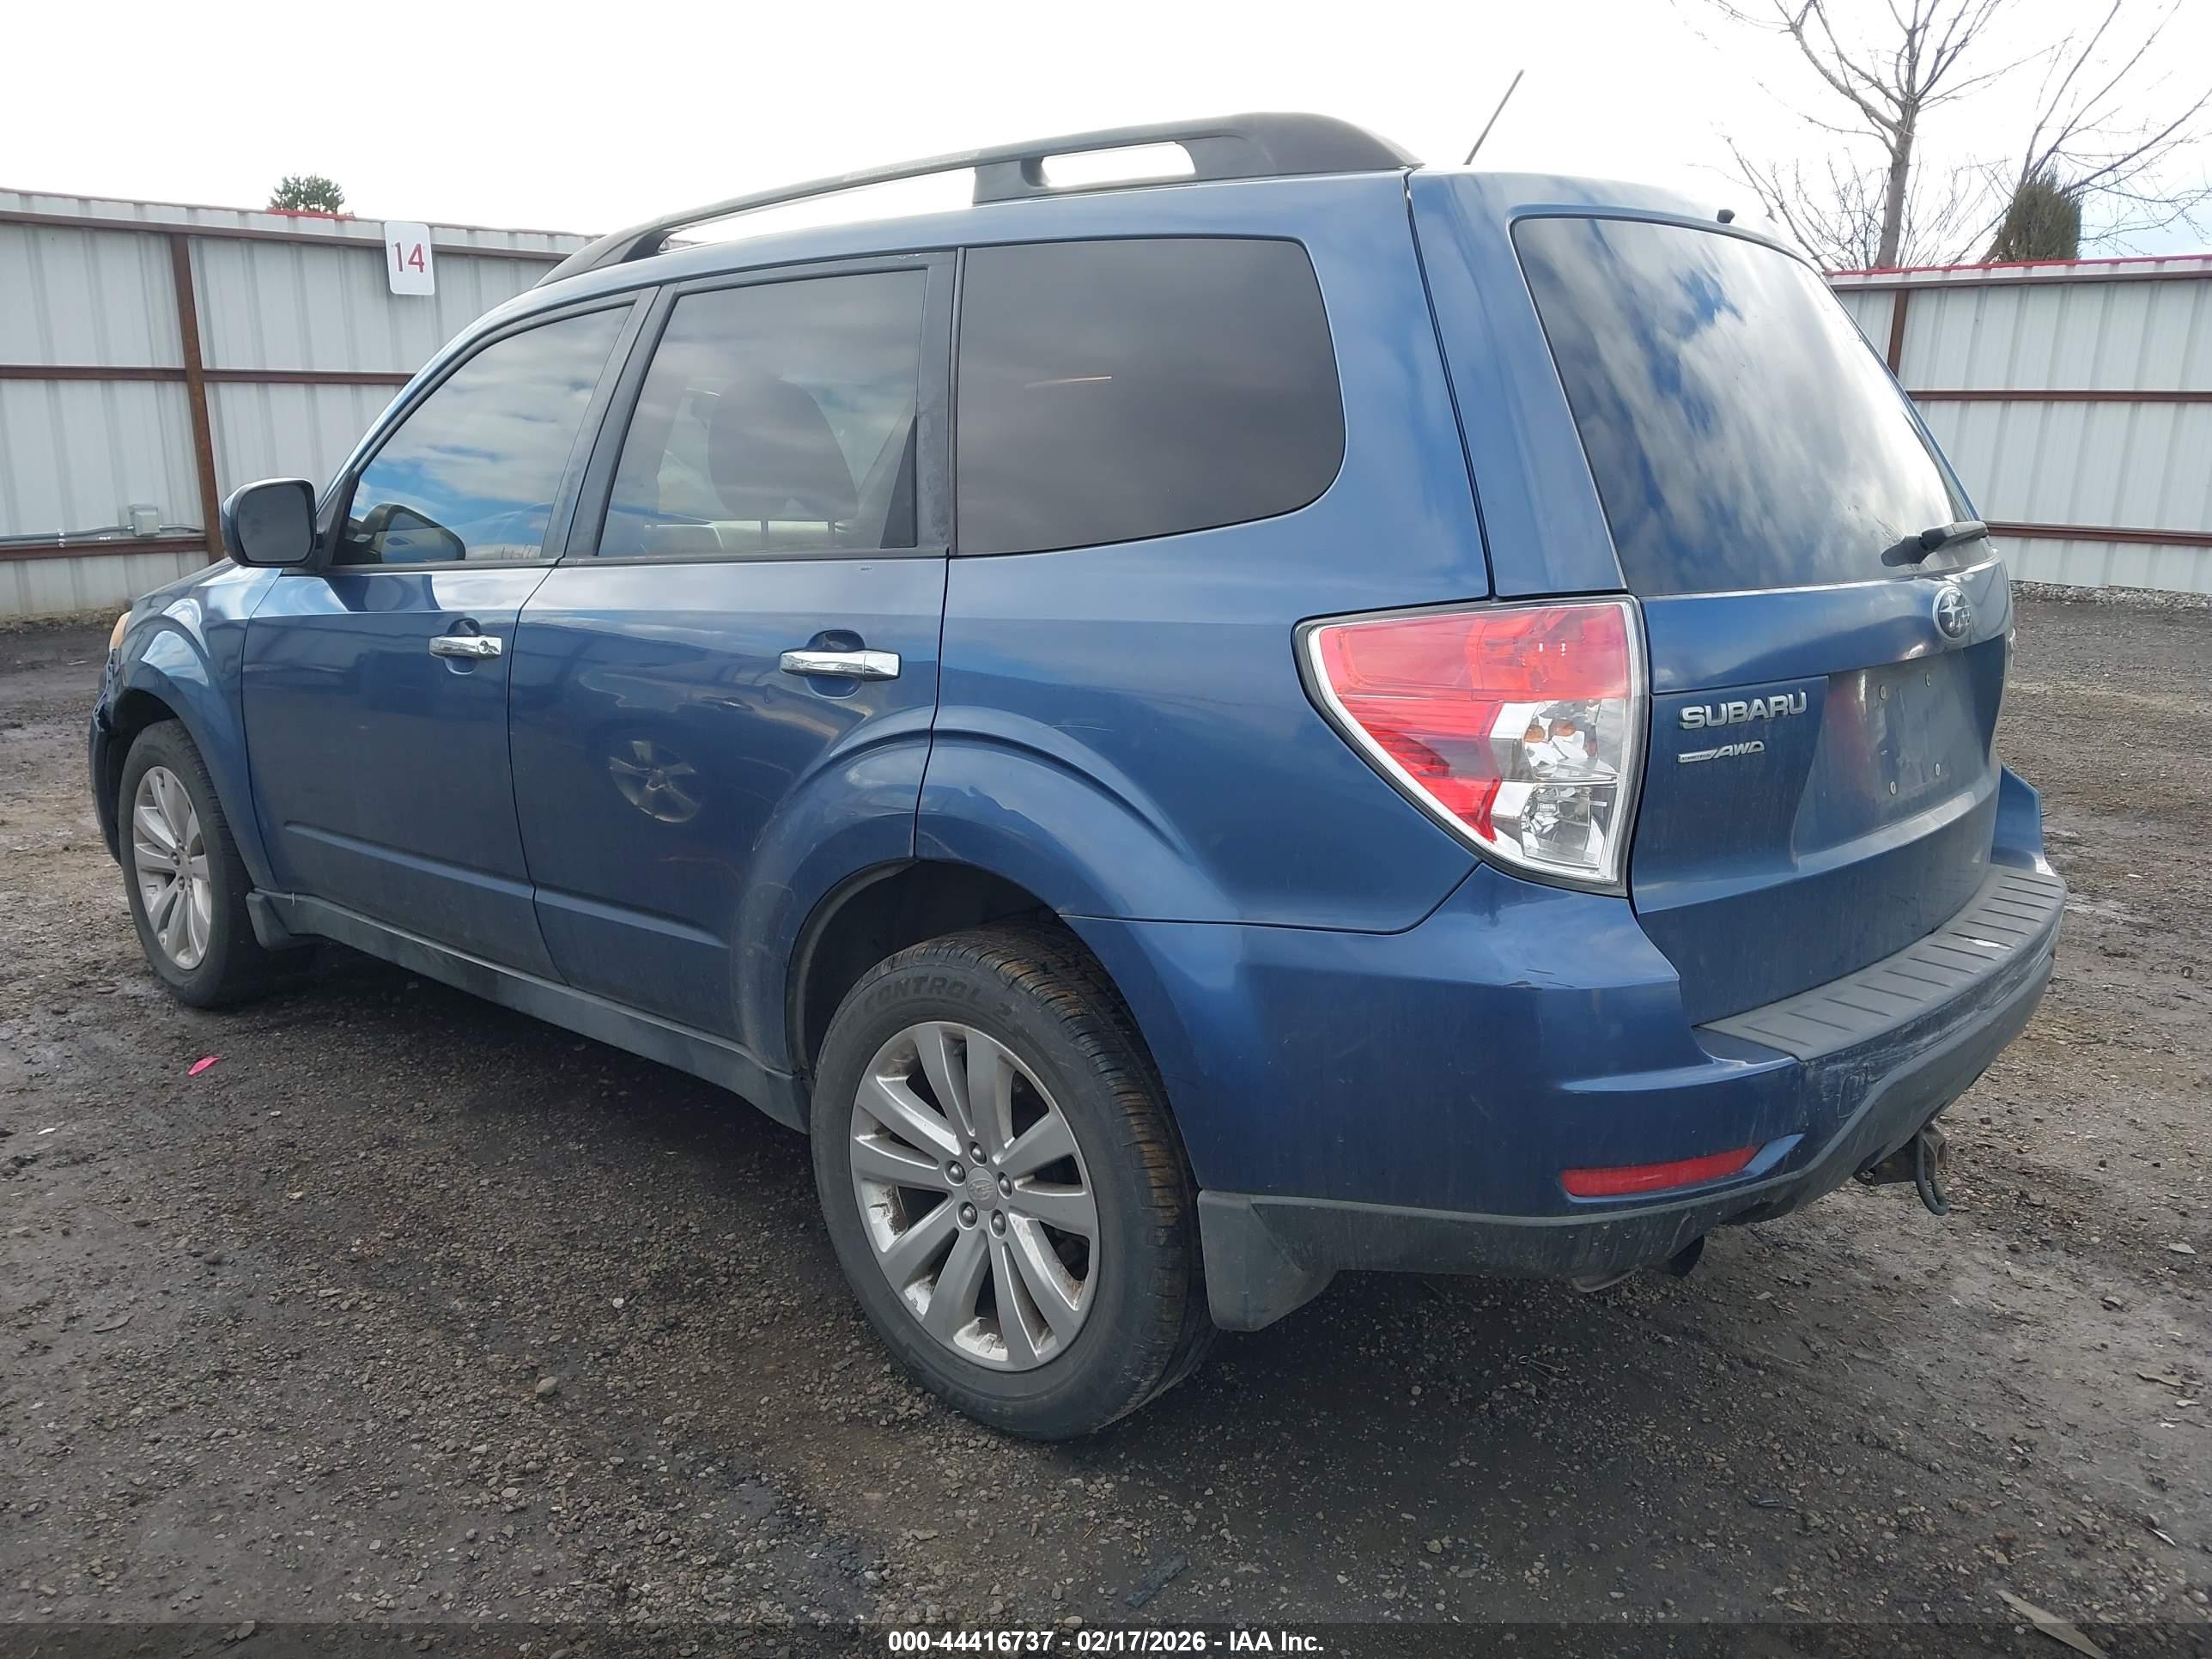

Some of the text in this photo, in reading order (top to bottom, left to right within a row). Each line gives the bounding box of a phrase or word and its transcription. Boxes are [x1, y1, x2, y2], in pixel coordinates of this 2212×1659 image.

[395, 242, 424, 273] 14
[1680, 690, 1807, 730] SUBARU
[1713, 740, 1765, 759] AWD
